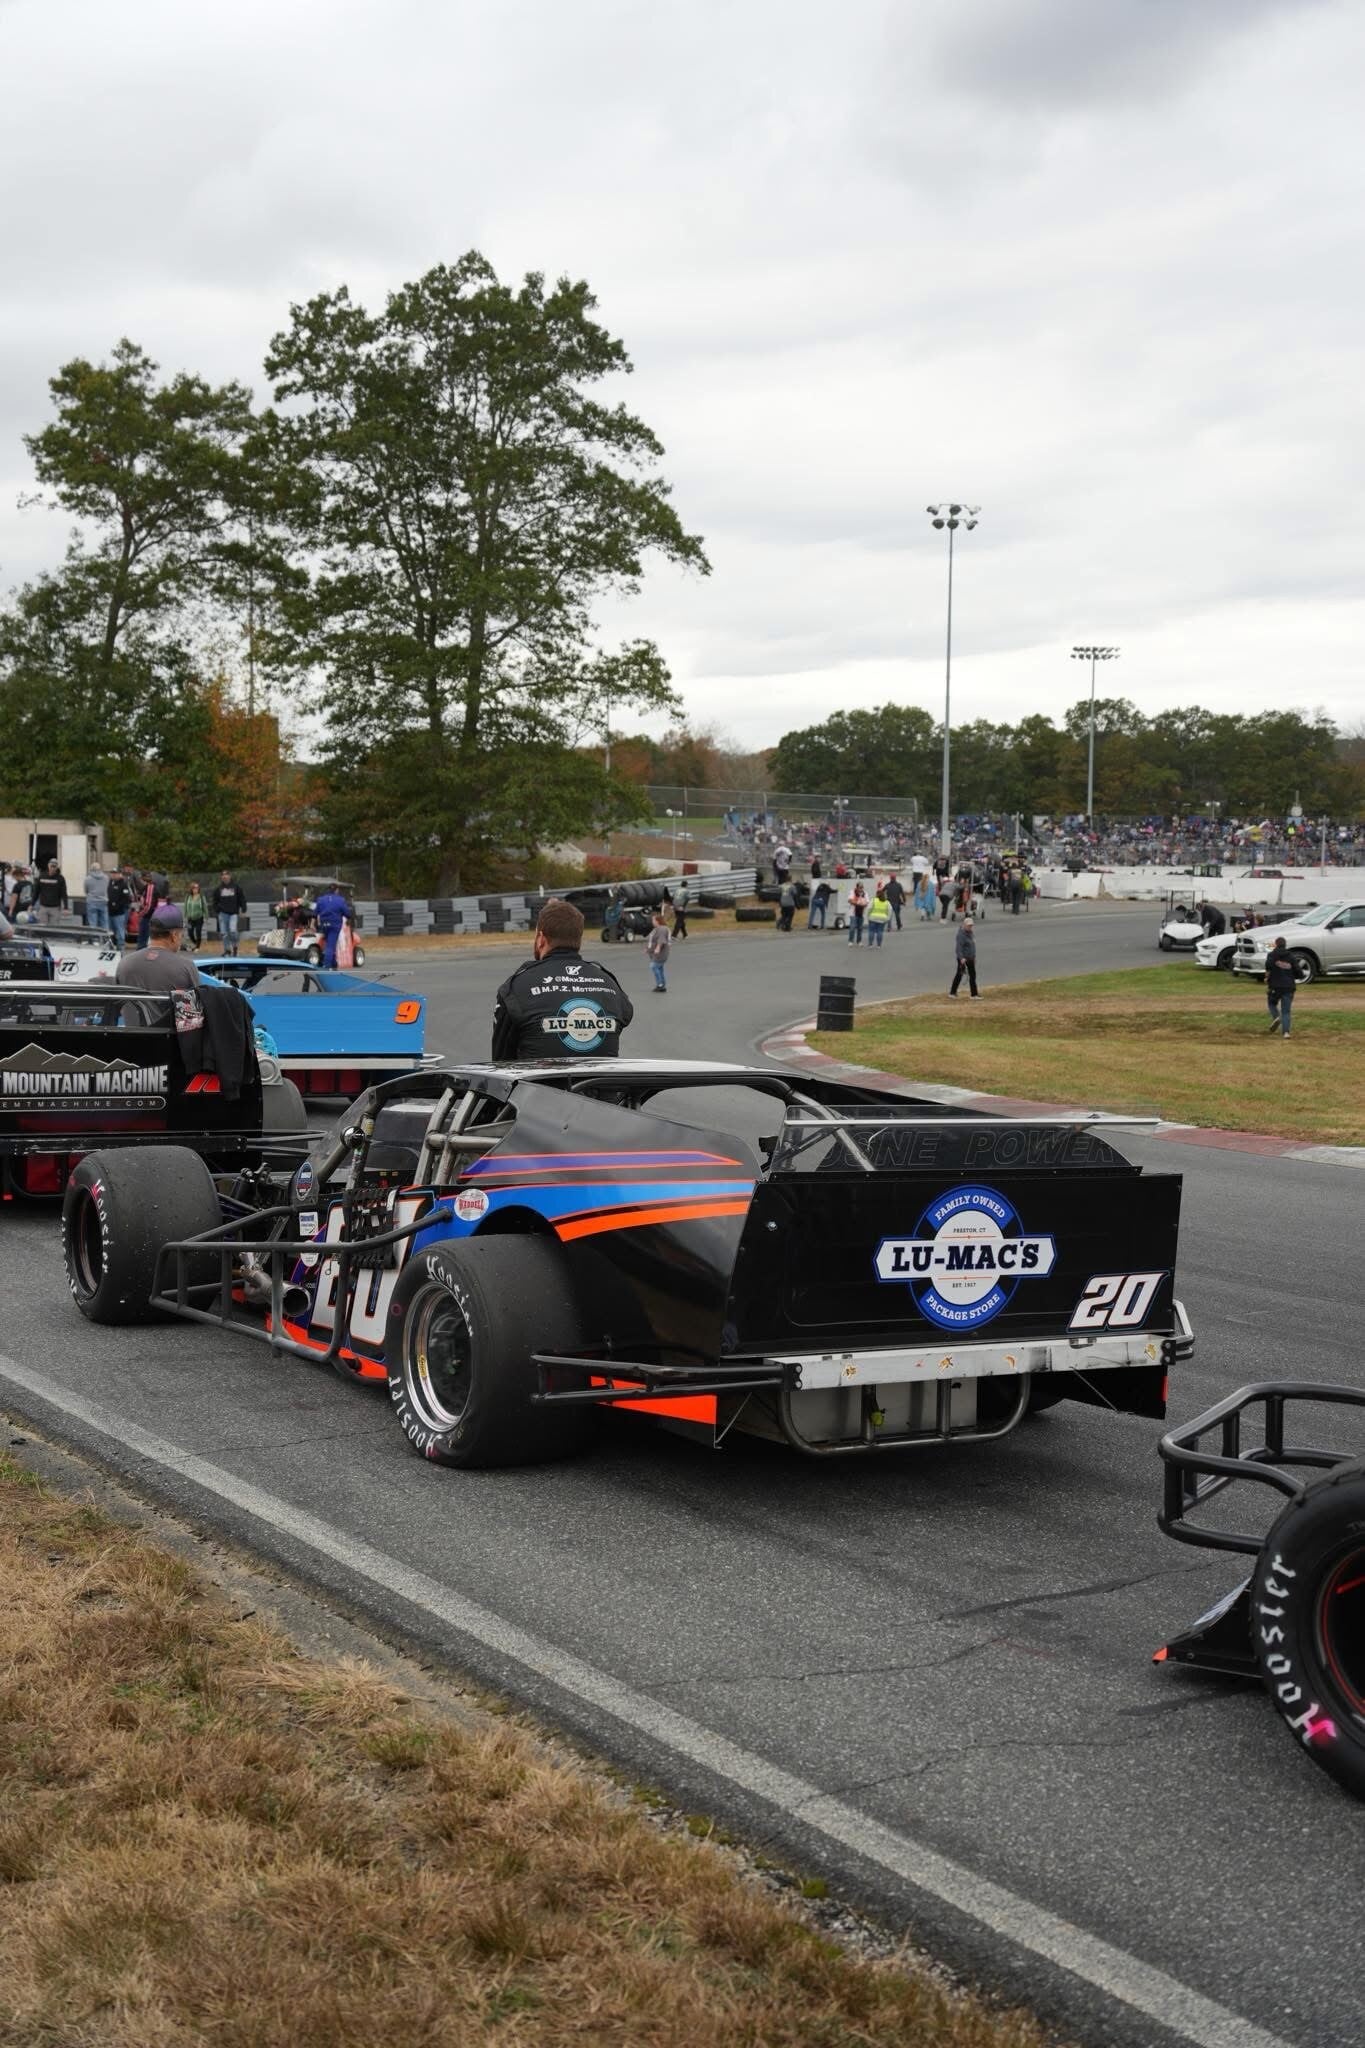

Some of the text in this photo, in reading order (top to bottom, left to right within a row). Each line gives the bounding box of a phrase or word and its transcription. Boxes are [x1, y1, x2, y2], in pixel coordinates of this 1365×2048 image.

[61, 962, 76, 972] 77
[97, 951, 116, 961] 79
[393, 1000, 421, 1024] 9
[3, 1065, 168, 1094] MOUNTAIN MACHINE
[963, 1129, 1114, 1166] POWER
[934, 1195, 1006, 1221] FAMILY OWNED
[891, 1240, 1039, 1273] LU-MAC'S
[926, 1293, 1000, 1321] PACKAGE STORE
[1068, 1271, 1166, 1331] 20
[1257, 1554, 1337, 1747] Hoosier
